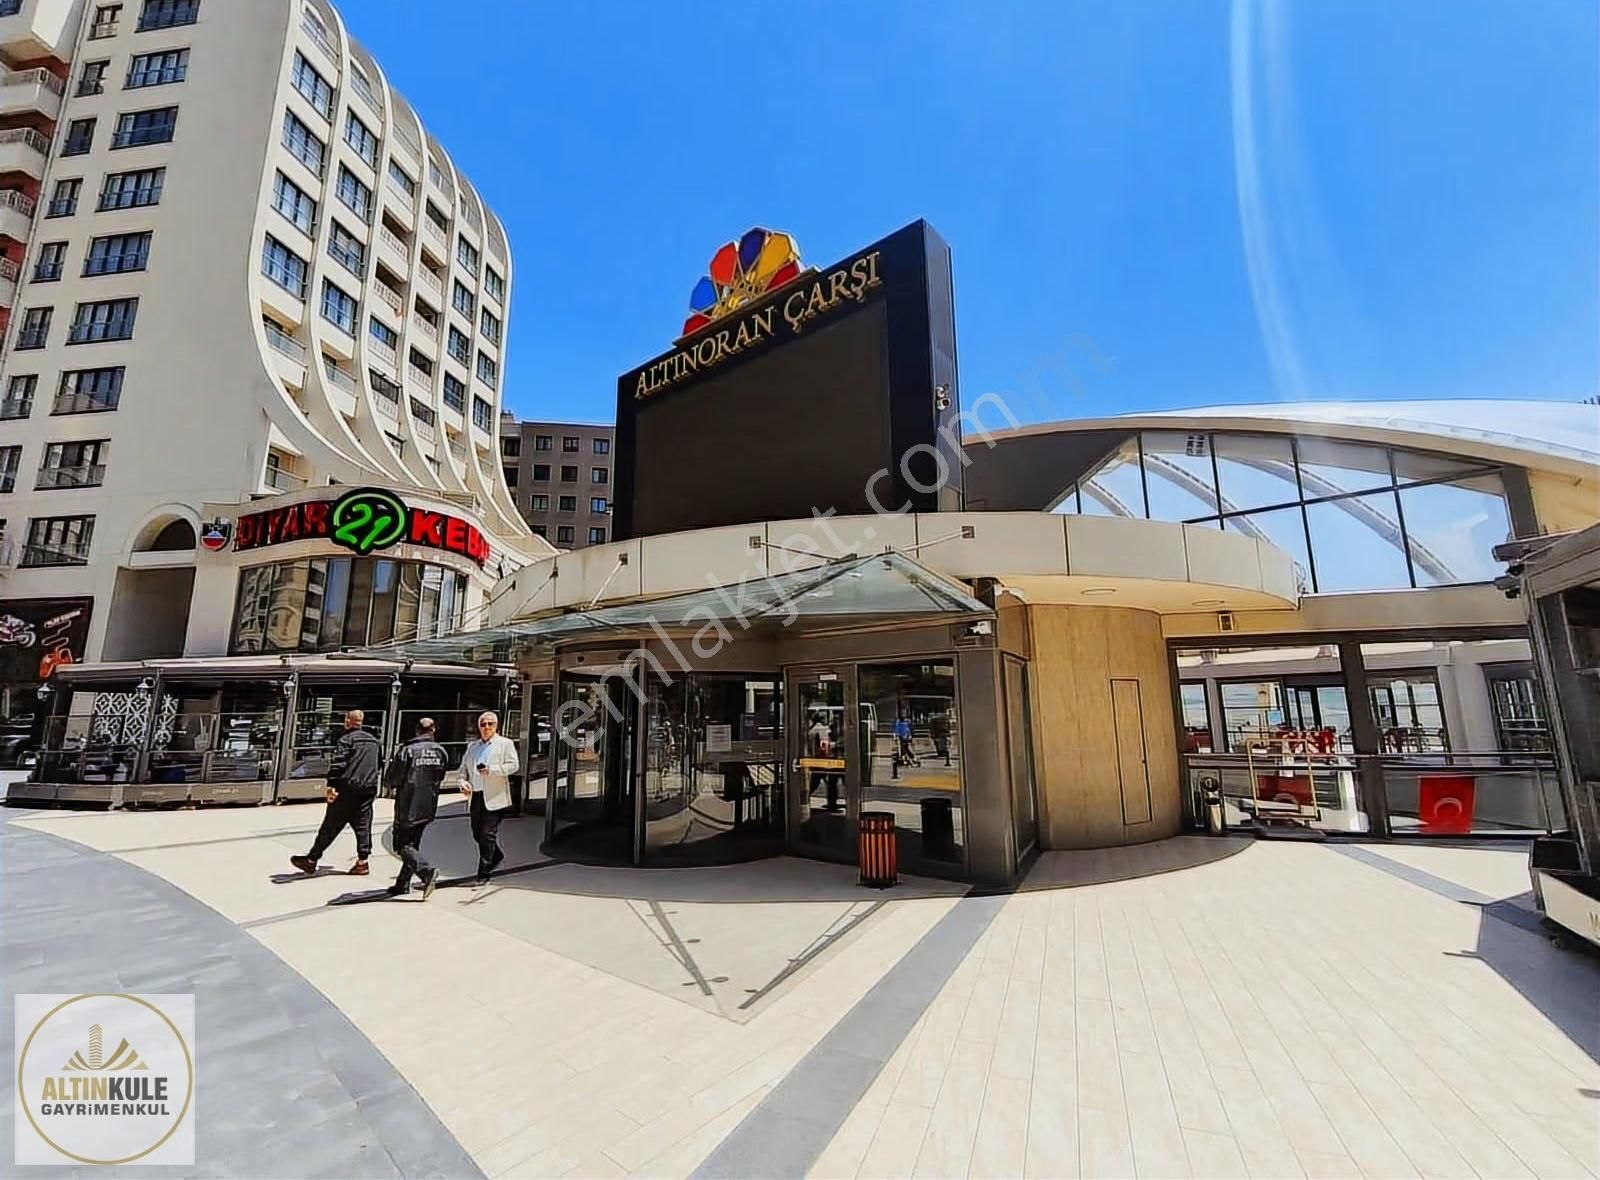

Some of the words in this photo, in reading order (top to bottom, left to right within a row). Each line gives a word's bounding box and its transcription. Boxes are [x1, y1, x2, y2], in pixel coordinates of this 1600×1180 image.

[634, 305, 775, 399] ALTINORAN
[784, 251, 883, 331] ÇARŞI
[335, 503, 391, 550] 21
